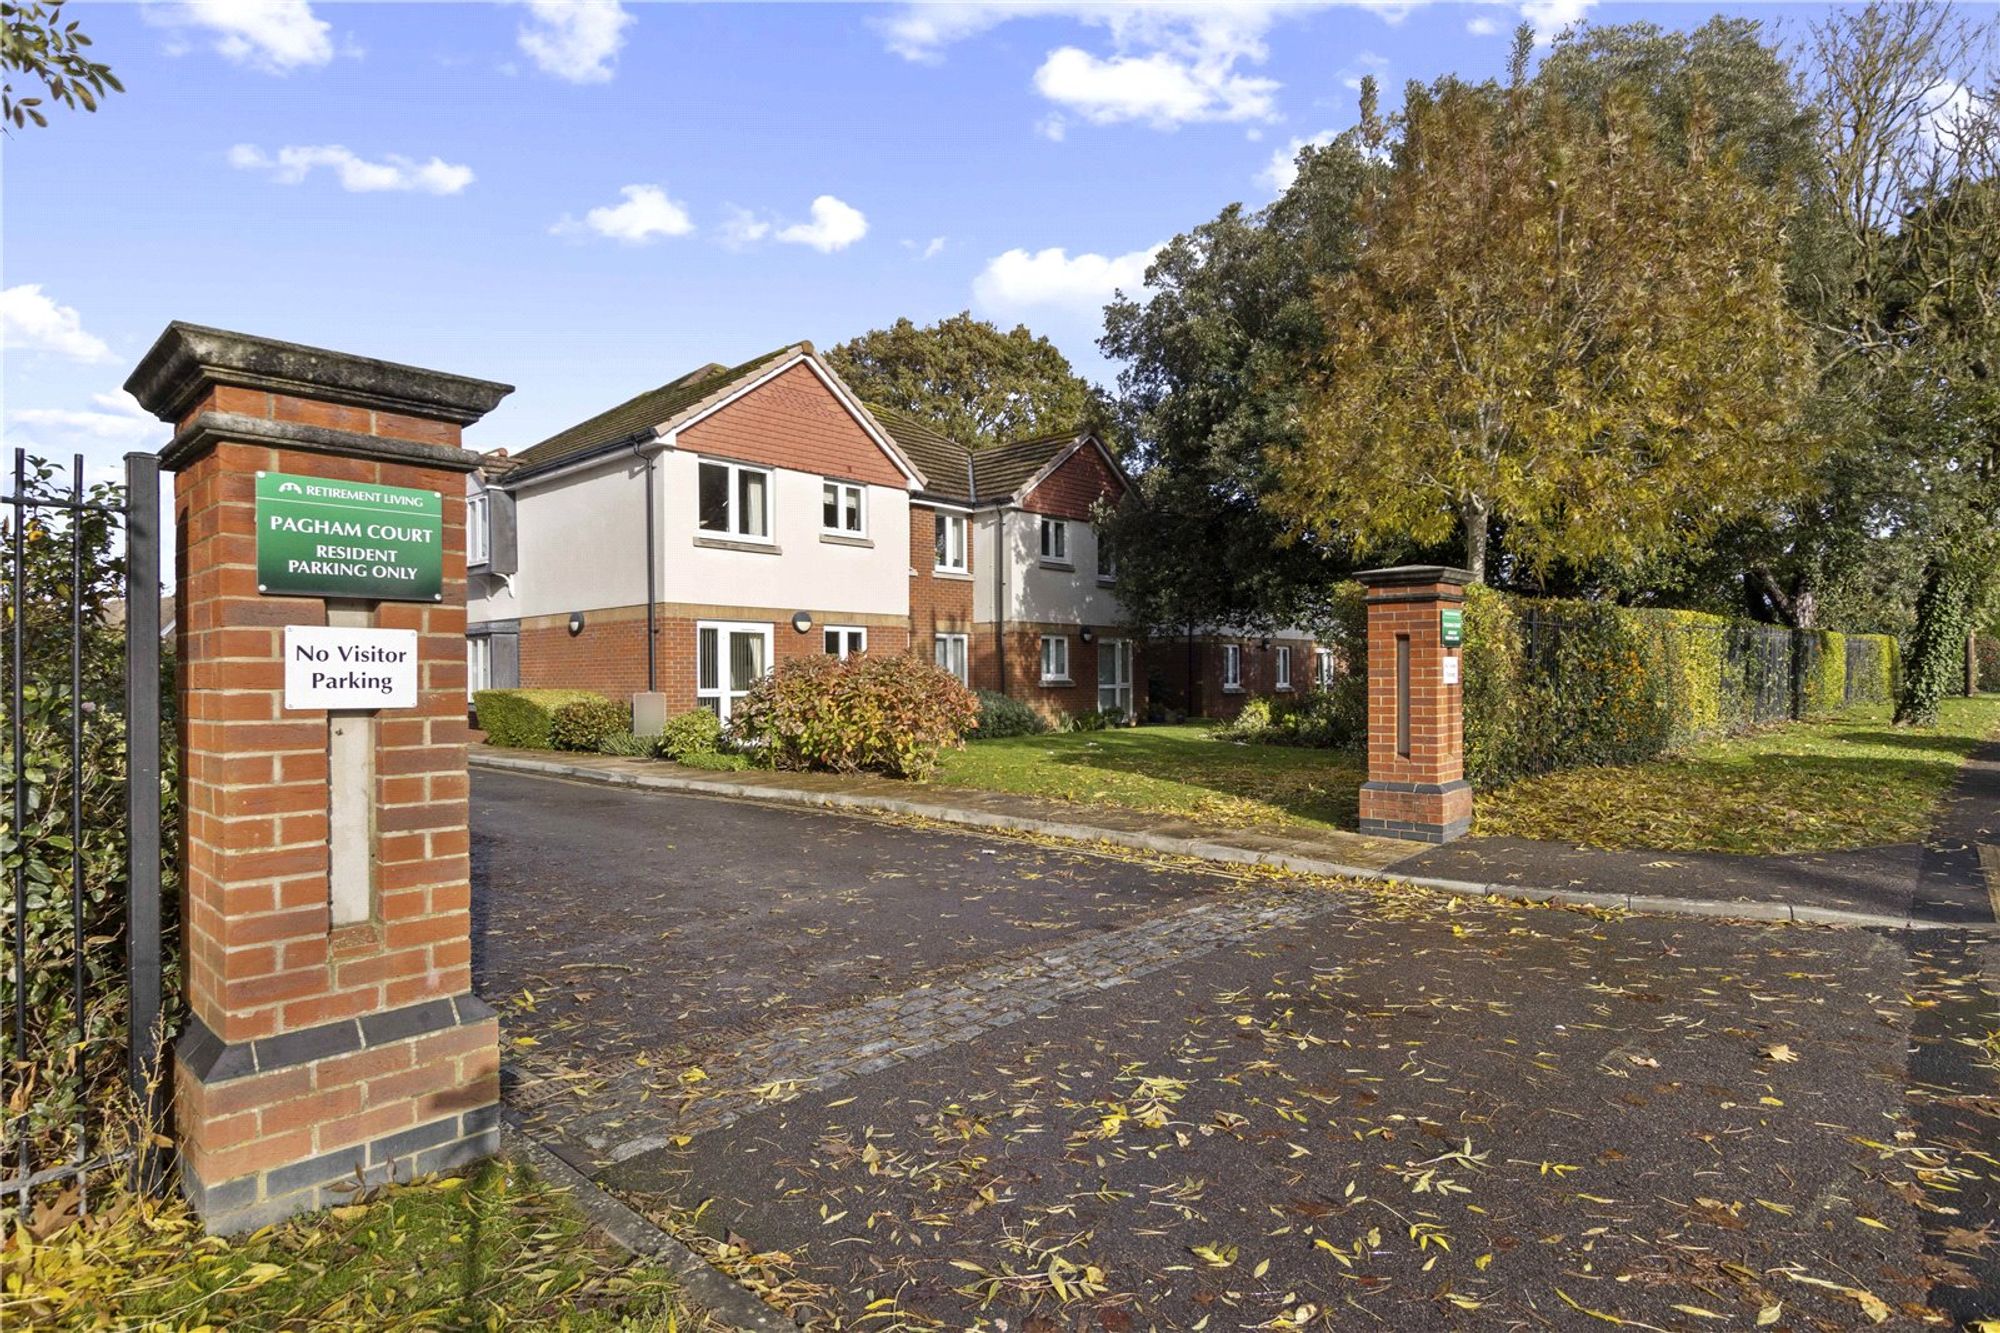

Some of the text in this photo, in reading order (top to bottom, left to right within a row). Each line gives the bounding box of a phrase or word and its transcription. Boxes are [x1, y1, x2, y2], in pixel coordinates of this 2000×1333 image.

[306, 485, 424, 507] RETIREMENT LIVING
[270, 516, 433, 543] PAGHAM COURT
[316, 545, 398, 563] RESIDENT
[288, 560, 418, 580] PARKING ONLY
[296, 645, 407, 663] No Visitor
[312, 672, 393, 694] Parking
